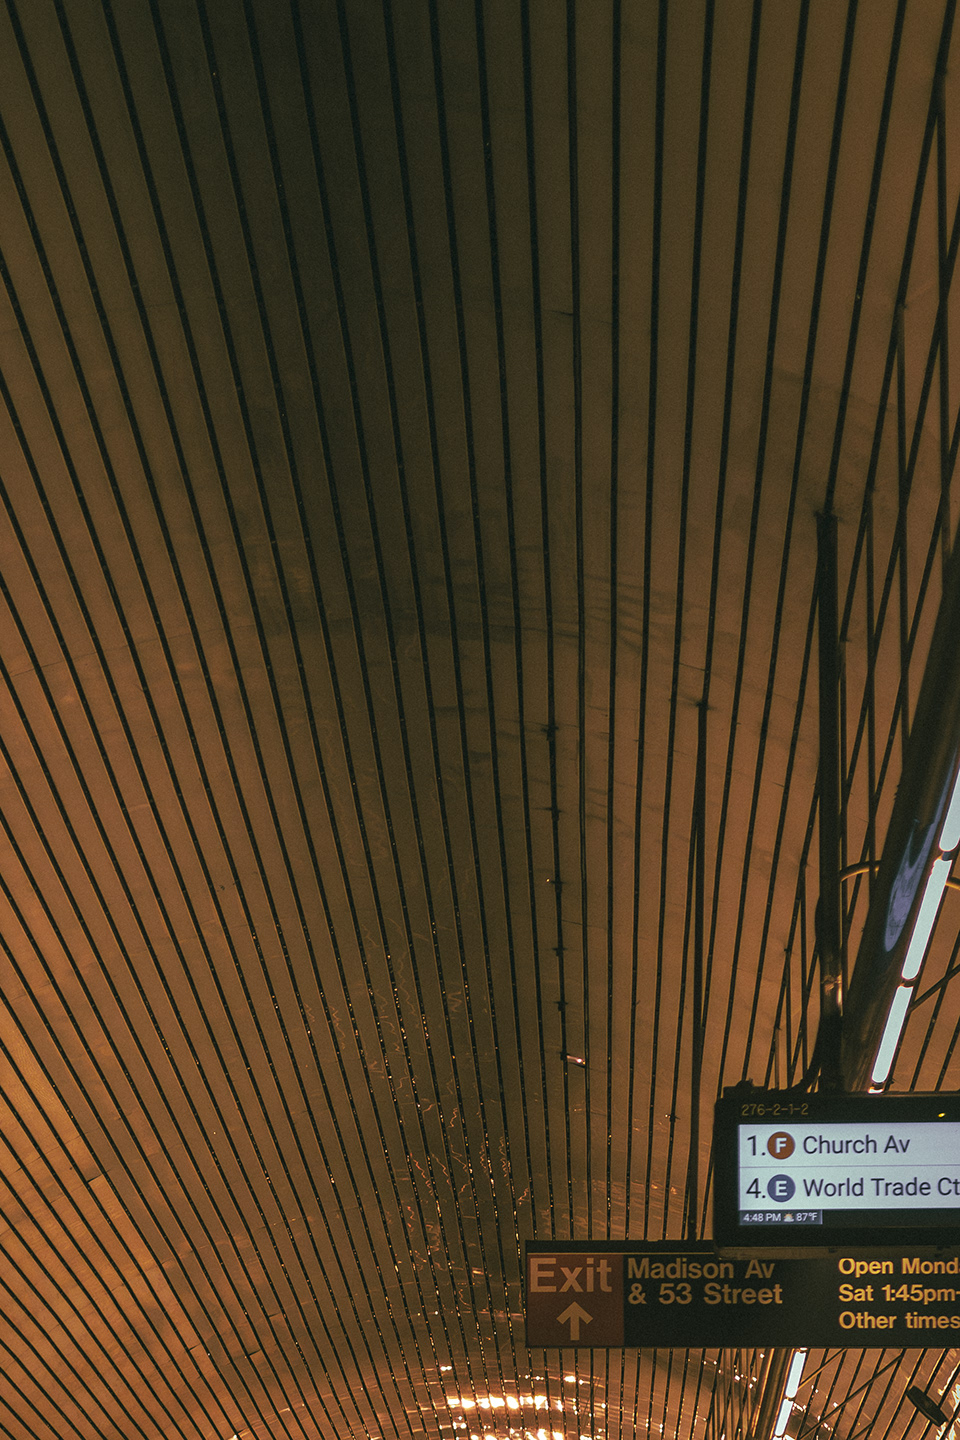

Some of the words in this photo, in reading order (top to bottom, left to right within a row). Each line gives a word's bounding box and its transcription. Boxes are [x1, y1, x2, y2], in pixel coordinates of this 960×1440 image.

[741, 1103, 809, 1116] 276-2-1-2
[747, 1135, 766, 1156] 1.
[775, 1137, 788, 1153] F
[803, 1134, 877, 1154] Church
[884, 1135, 911, 1153] Av
[745, 1177, 766, 1199] 4.
[775, 1181, 788, 1196] E
[802, 1177, 864, 1197] World
[870, 1177, 931, 1196] Trade
[743, 1213, 764, 1221] 4:48
[766, 1213, 782, 1222] PM
[529, 1257, 612, 1293] Exit
[627, 1257, 734, 1279] Madison
[745, 1259, 775, 1279] Av
[838, 1257, 894, 1278] Open
[901, 1257, 960, 1275] Mond
[627, 1283, 647, 1304] &
[658, 1283, 692, 1304] 53
[703, 1282, 783, 1304] Street
[838, 1283, 874, 1302] Sat
[838, 1311, 897, 1329] Other
[905, 1311, 960, 1329] times
